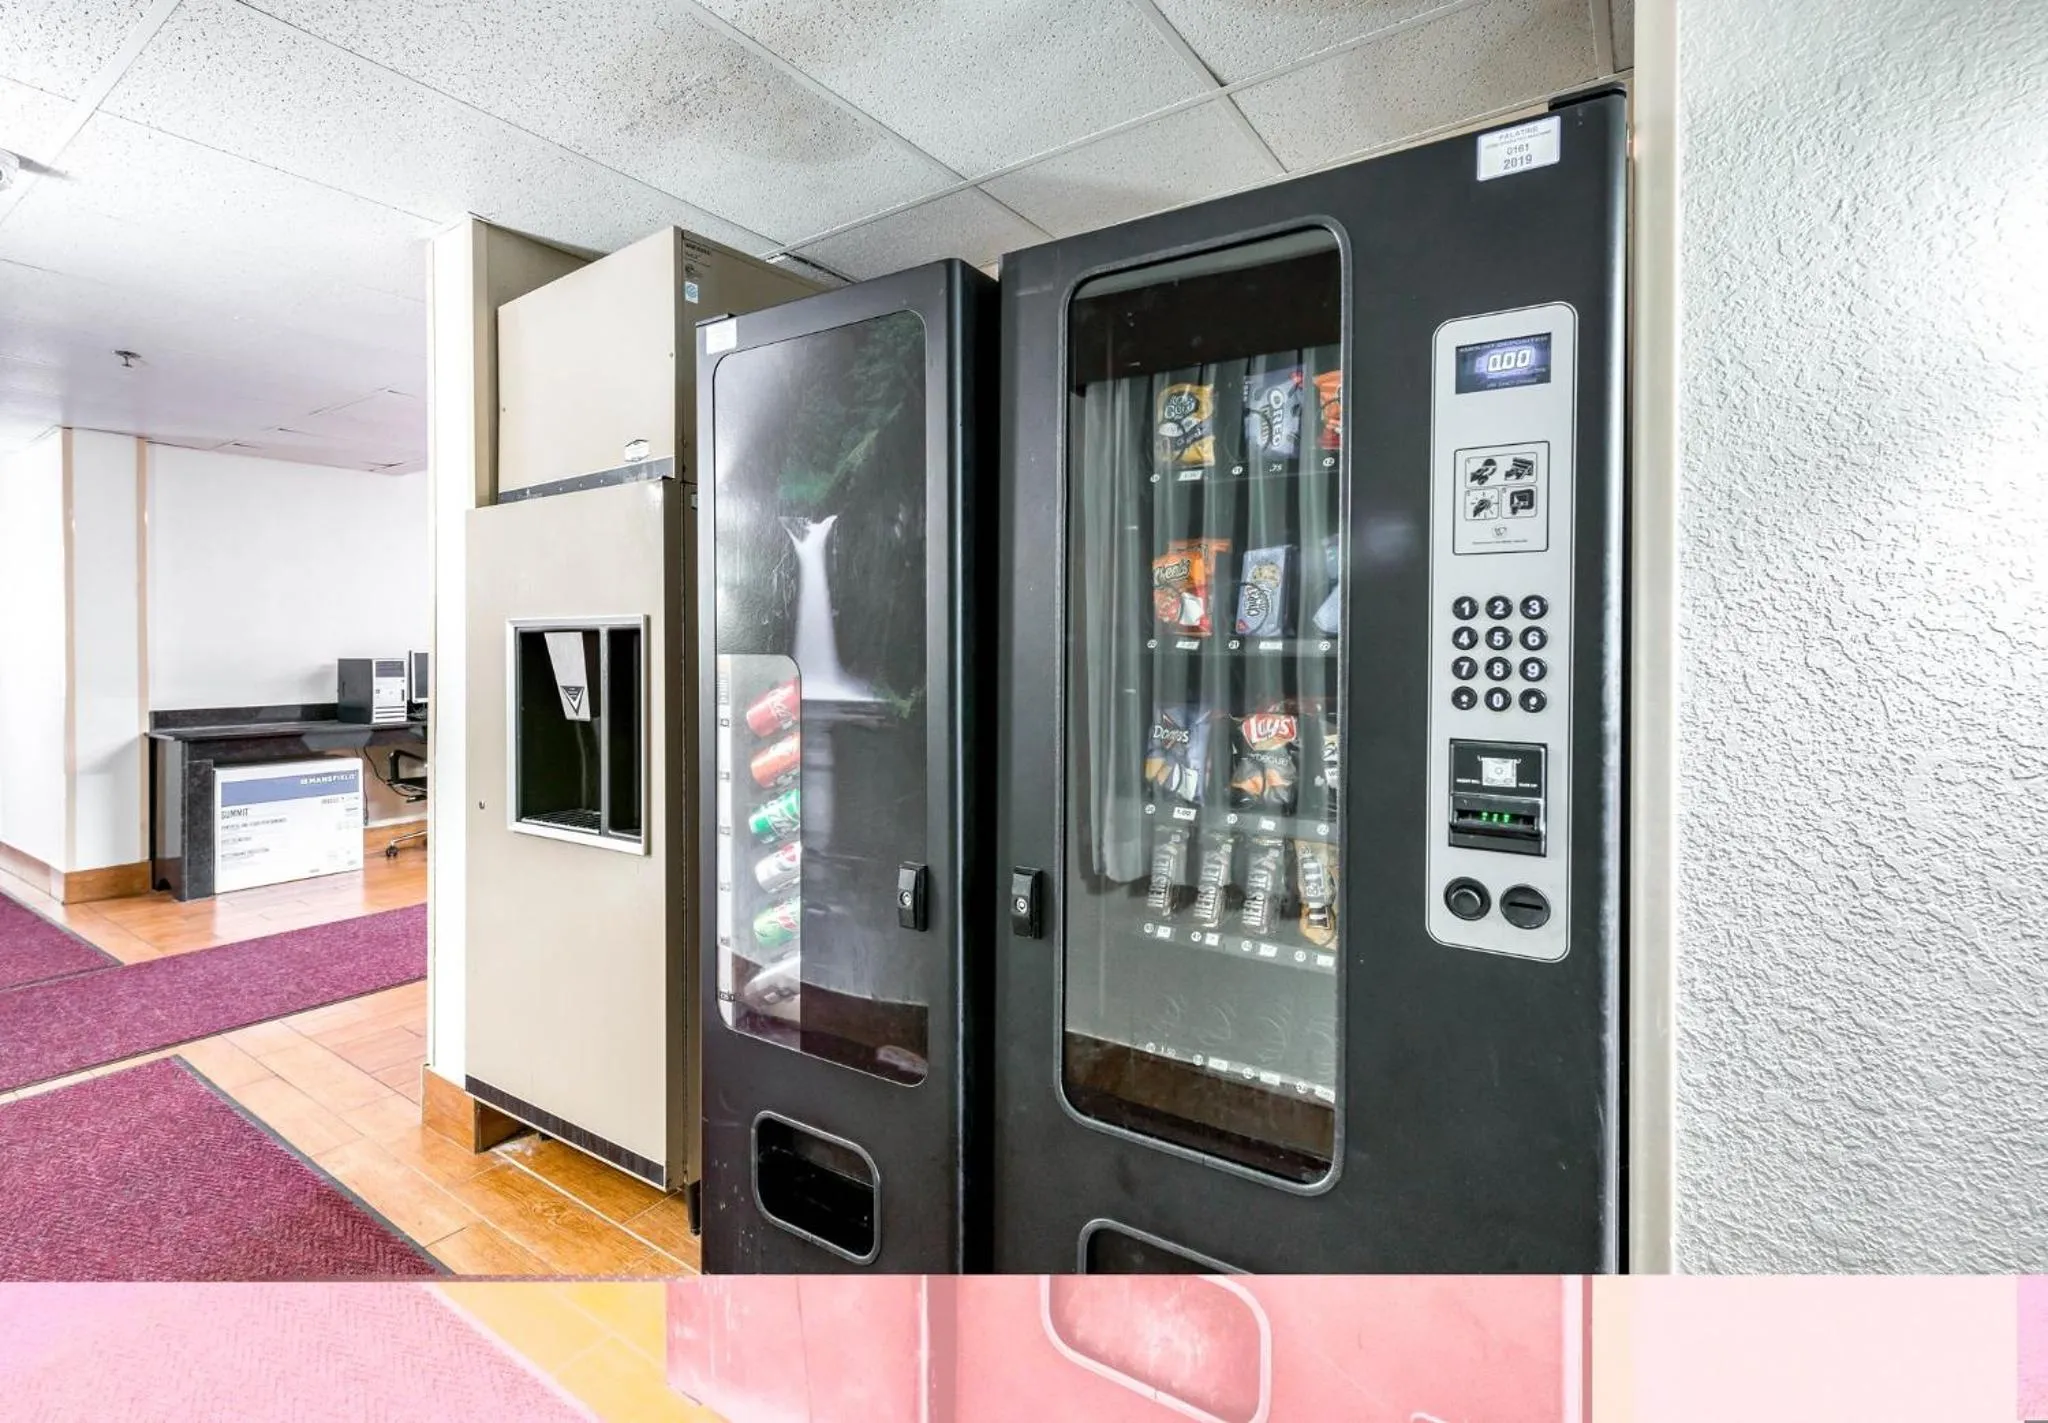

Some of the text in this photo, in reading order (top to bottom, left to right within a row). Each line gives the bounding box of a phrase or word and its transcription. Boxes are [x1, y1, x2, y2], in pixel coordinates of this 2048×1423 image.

[1504, 154, 1533, 170] 2019
[1270, 390, 1284, 447] OREO
[1461, 600, 1540, 616] 1 2 3
[1458, 631, 1540, 646] 4 5 6
[1459, 661, 1540, 678] 7 8 9
[1492, 693, 1504, 708] 0
[1153, 725, 1189, 743] Doritos
[1250, 715, 1290, 744] Lay's
[221, 808, 249, 820] SUMMIT
